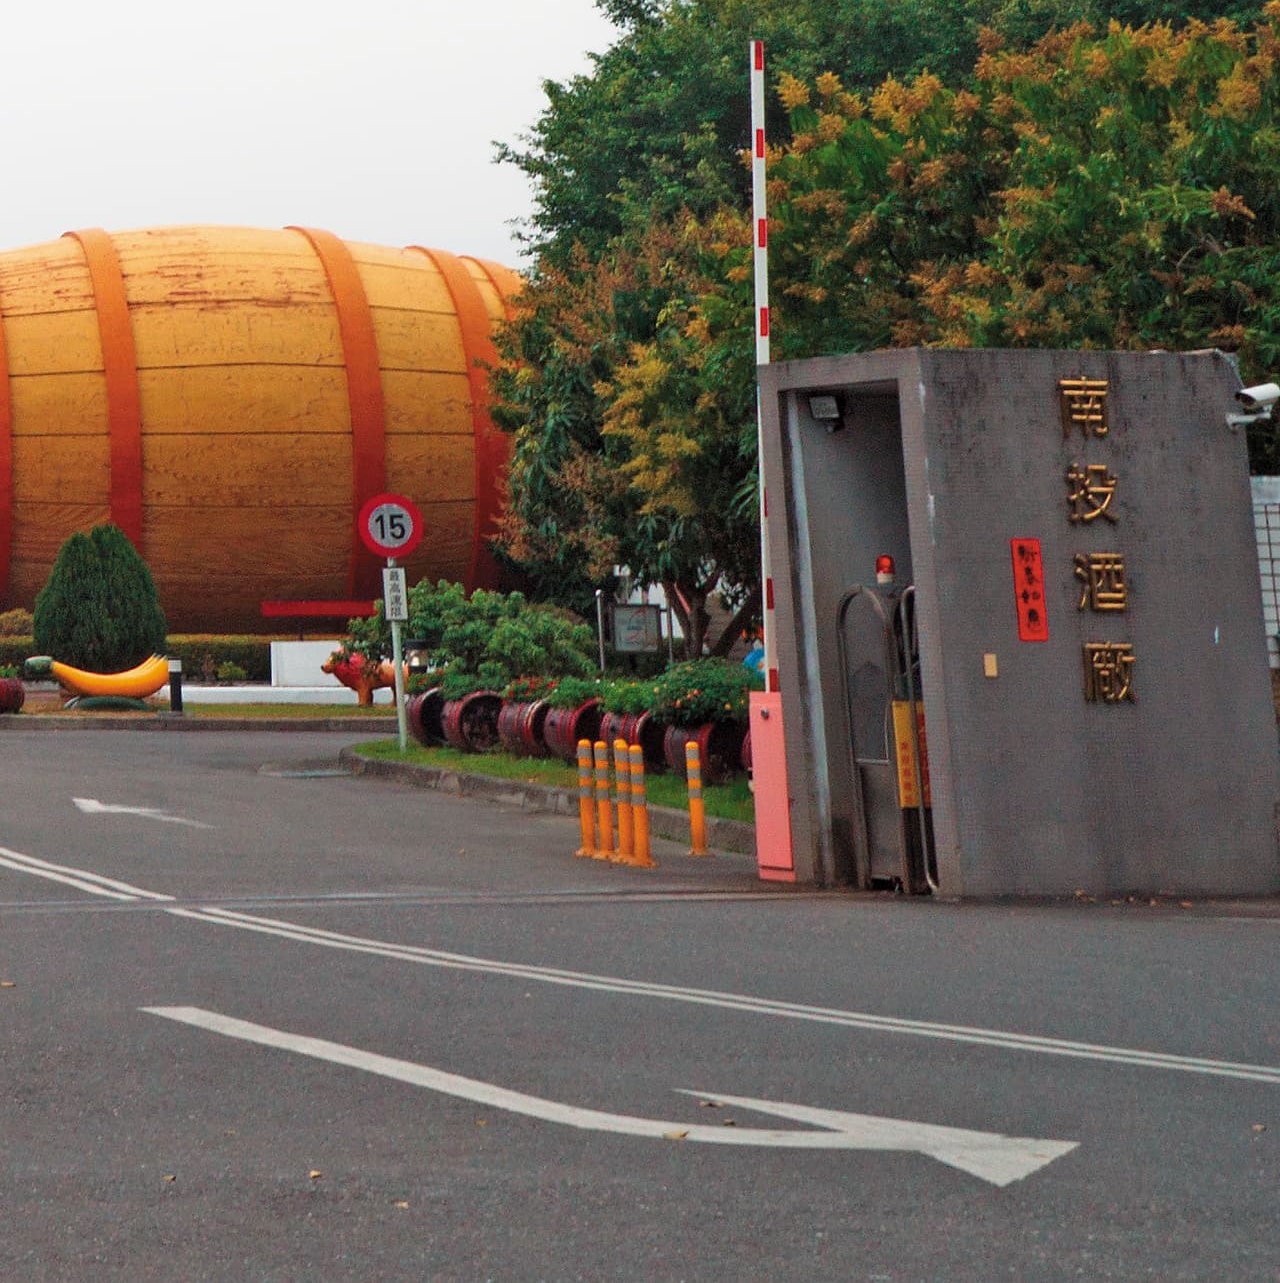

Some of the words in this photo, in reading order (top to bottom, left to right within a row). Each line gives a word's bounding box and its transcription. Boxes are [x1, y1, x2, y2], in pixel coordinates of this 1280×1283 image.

[374, 514, 406, 540] 15
[1059, 376, 1137, 703] 南投酒廠
